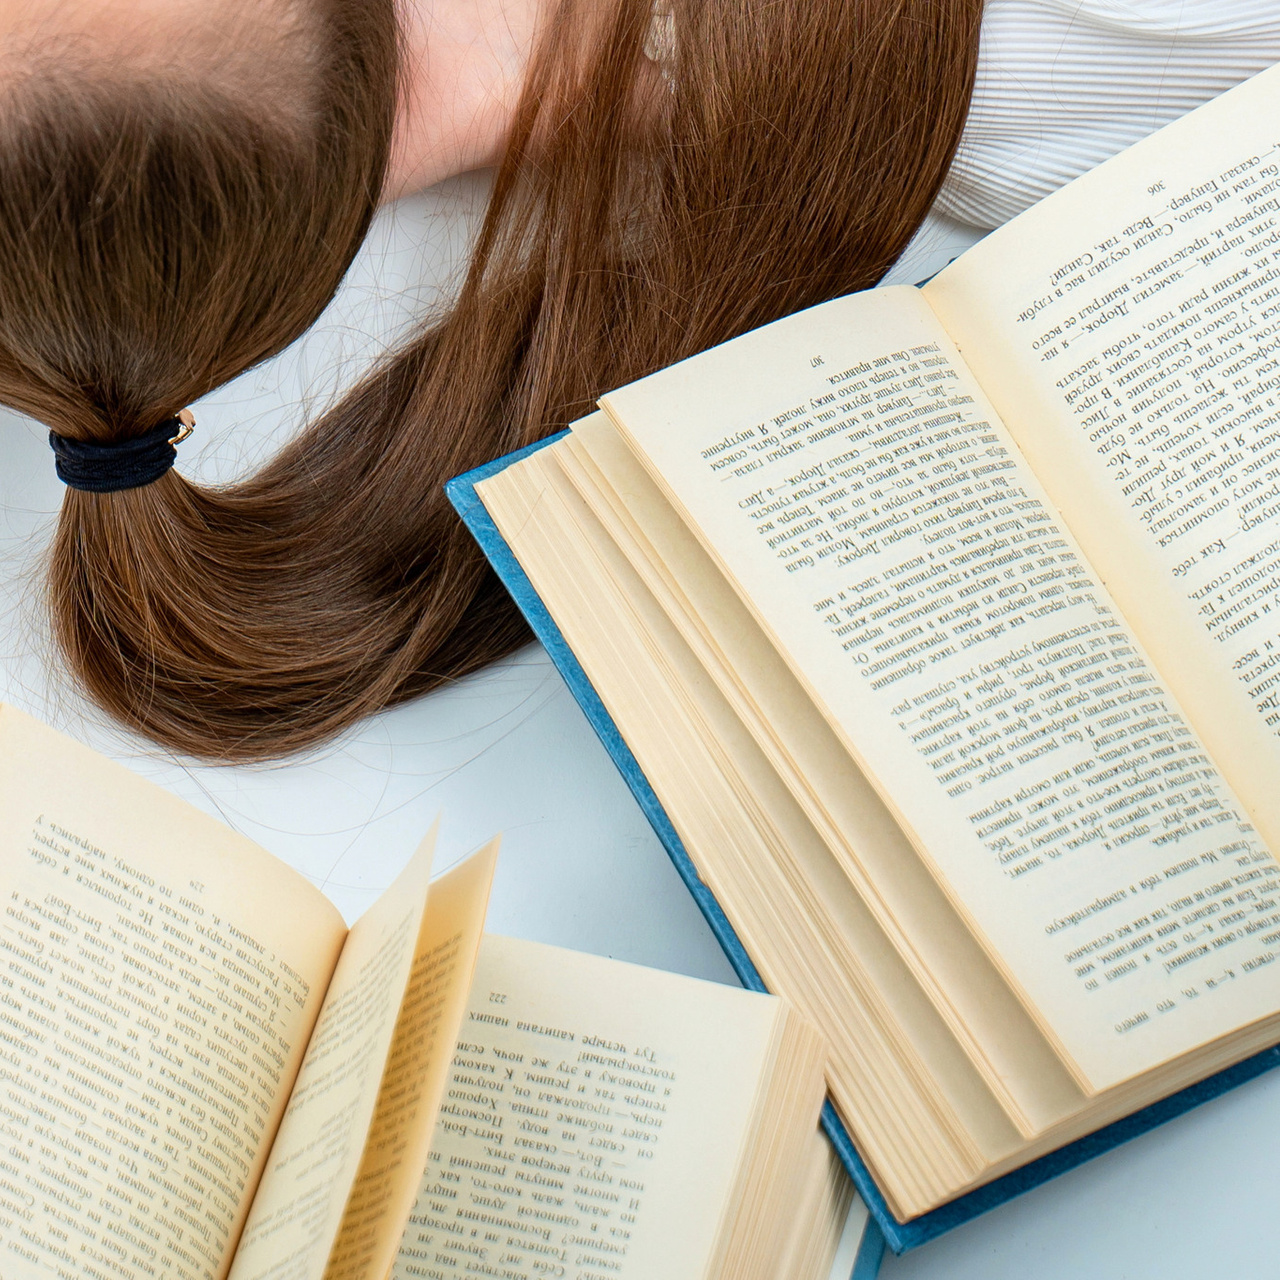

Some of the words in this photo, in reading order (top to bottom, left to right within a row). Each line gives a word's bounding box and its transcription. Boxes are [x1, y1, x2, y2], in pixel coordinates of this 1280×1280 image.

[1146, 179, 1167, 197] 306
[1172, 199, 1214, 224] было,
[1121, 215, 1156, 238] Ведь
[1131, 222, 1175, 251] Санди
[1092, 235, 1122, 254] так,
[1048, 252, 1095, 288] Санди?
[1086, 246, 1132, 278] осудил
[1063, 273, 1087, 293] вас
[1210, 266, 1253, 295] жизни
[1053, 287, 1065, 299] в
[1077, 282, 1131, 321] выиграл
[1177, 287, 1210, 315] ради
[1015, 294, 1055, 324] глуби-
[1062, 315, 1078, 330] ее
[1141, 310, 1178, 332] того,
[1192, 309, 1239, 341] самого
[1215, 314, 1258, 346] утром
[1031, 324, 1064, 351] всего
[1100, 332, 1142, 361] чтобы
[1195, 342, 1214, 357] на
[808, 354, 824, 368] 307
[1111, 336, 1194, 389] Капабланки.
[1184, 341, 1246, 382] который,
[1054, 356, 1101, 390] заехать
[1124, 354, 1194, 401] состязание
[1193, 377, 1217, 395] Но
[1112, 397, 1123, 409] в
[1130, 378, 1183, 416] получив
[1079, 404, 1111, 431] Лисс
[1145, 392, 1192, 424] только
[1088, 412, 1128, 444] ночью
[1127, 420, 1145, 437] не
[1096, 432, 1127, 456] будь
[34, 813, 45, 826] у
[49, 822, 107, 861] набрались
[113, 855, 156, 889] одному,
[158, 885, 174, 899] по
[177, 895, 206, 917] один
[211, 912, 222, 927] и,
[226, 922, 267, 956] людьми,
[487, 991, 508, 1006] 222
[467, 1010, 510, 1028] наших
[515, 1020, 576, 1043] капитана
[491, 1046, 525, 1064] ночь,
[580, 1034, 628, 1055] четыре
[633, 1046, 654, 1062] Тут
[449, 1053, 497, 1075] какому
[530, 1056, 551, 1069] же
[555, 1059, 579, 1076] эту
[576, 1050, 676, 1082] толстокрылый!
[452, 1073, 505, 1094] получив
[502, 1066, 515, 1082] К
[522, 1070, 571, 1091] решим.
[583, 1068, 593, 1080] в
[597, 1071, 657, 1095] провожу
[511, 1083, 532, 1099] он,
[576, 1083, 587, 1095] и
[593, 1086, 616, 1102] так
[662, 1086, 672, 1097] я
[446, 1088, 500, 1112] Хорошо
[507, 1100, 550, 1120] птица.
[536, 1090, 612, 1117] продолжал
[622, 1093, 668, 1113] теперь
[516, 1118, 550, 1136] воду.
[555, 1112, 615, 1135] поближе
[560, 1129, 577, 1143] на
[587, 1136, 626, 1154] сядет
[621, 1127, 660, 1143] сядет
[636, 1147, 655, 1160] он
